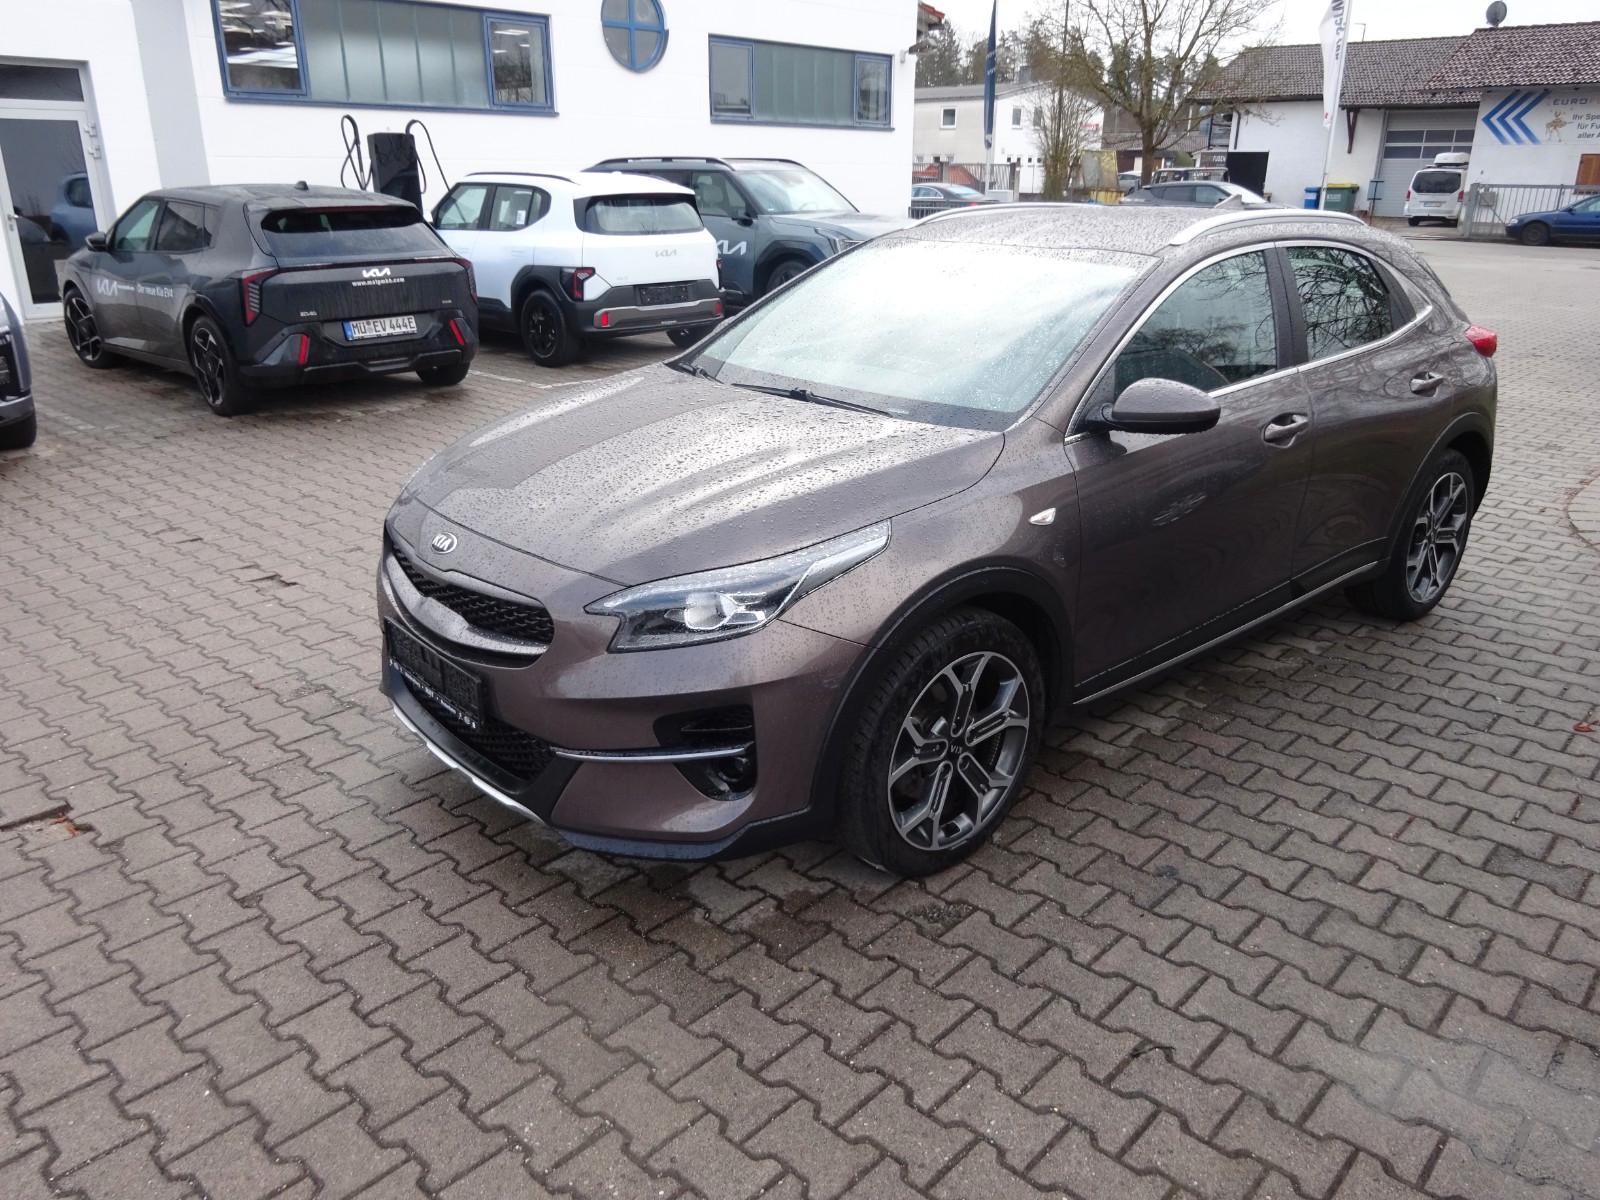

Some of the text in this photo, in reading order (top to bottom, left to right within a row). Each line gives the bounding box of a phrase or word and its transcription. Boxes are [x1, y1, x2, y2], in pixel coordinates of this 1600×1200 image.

[1572, 113, 1584, 121] Ihr
[362, 267, 391, 278] KIA
[352, 321, 367, 336] MÜ
[373, 319, 387, 333] EV
[389, 316, 416, 331] 444E
[432, 533, 453, 551] KIA
